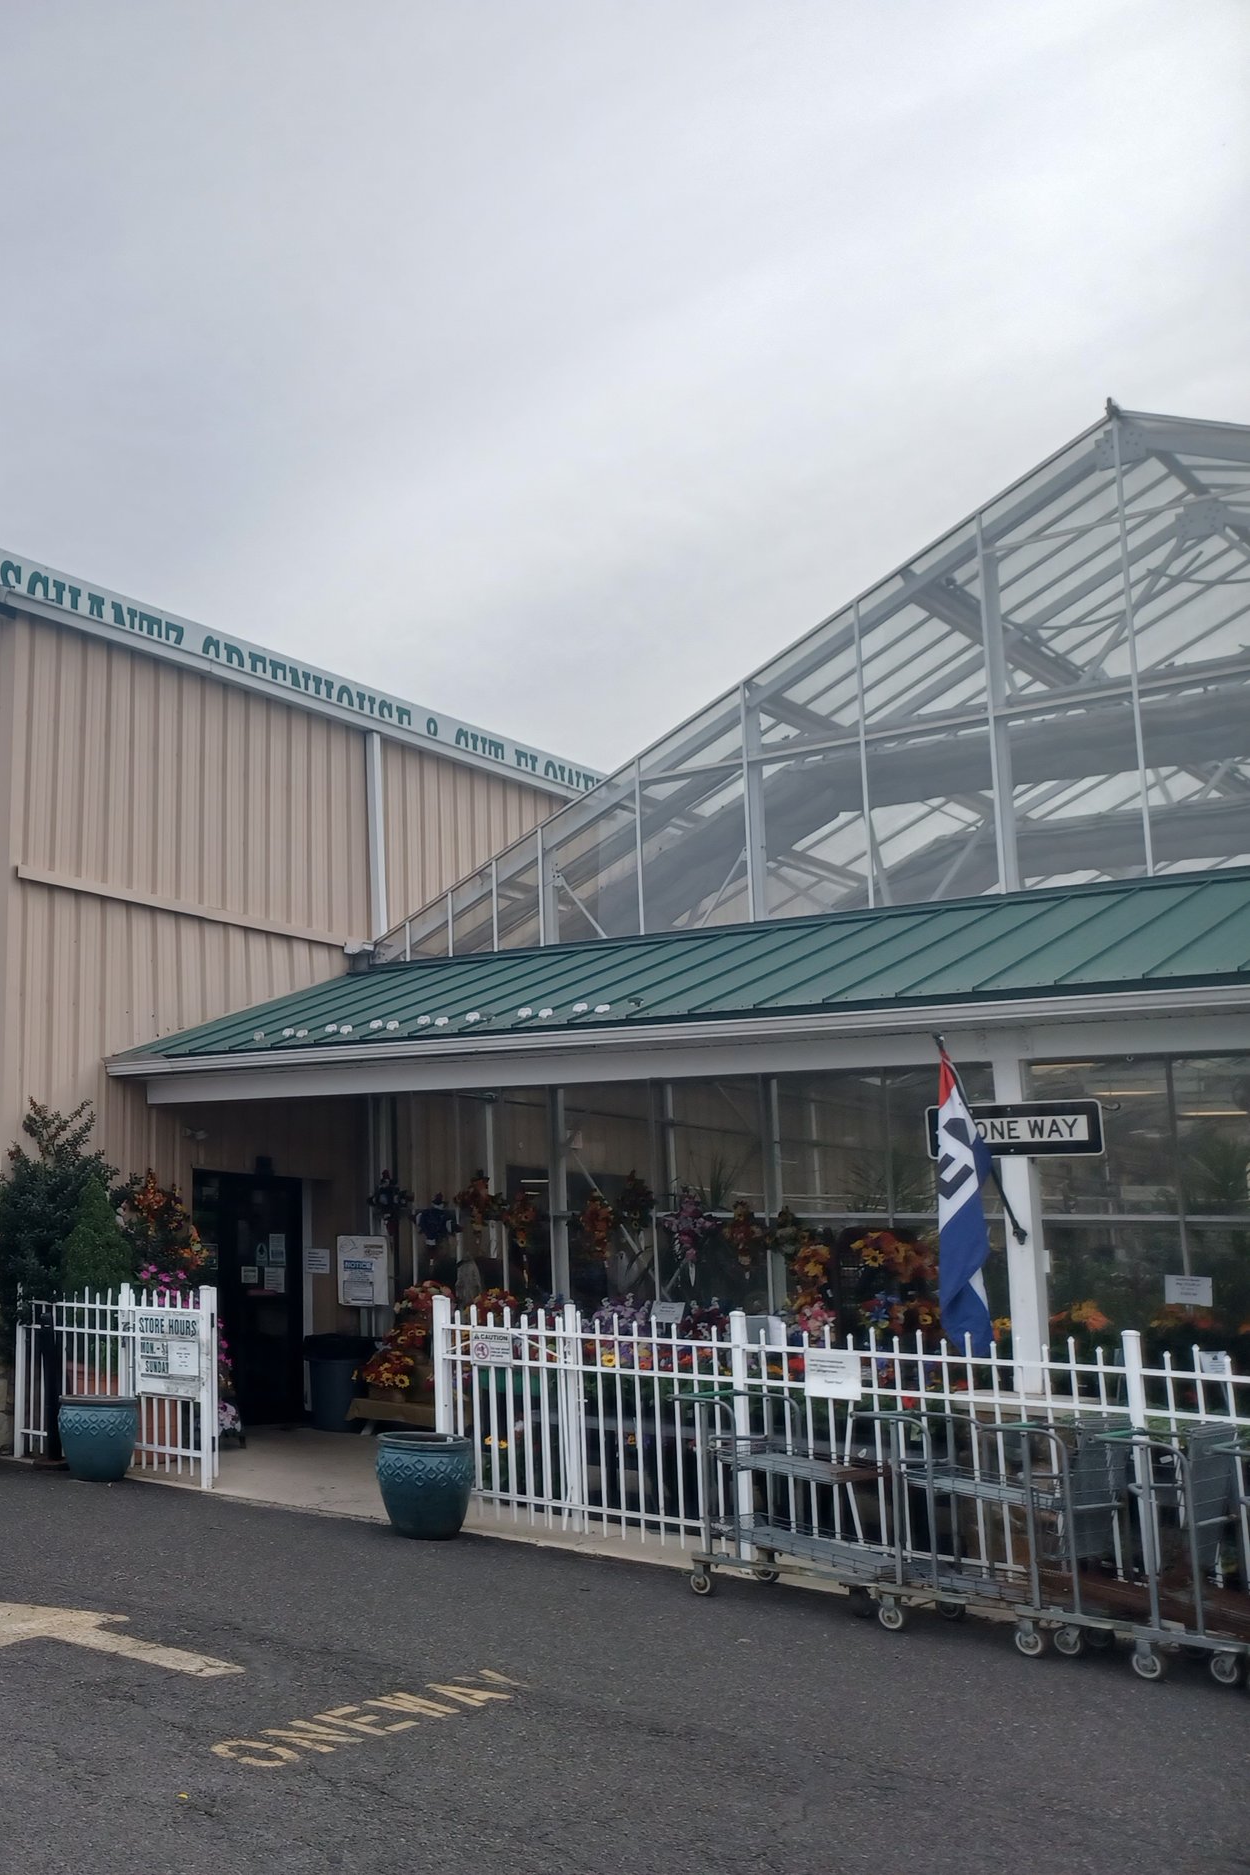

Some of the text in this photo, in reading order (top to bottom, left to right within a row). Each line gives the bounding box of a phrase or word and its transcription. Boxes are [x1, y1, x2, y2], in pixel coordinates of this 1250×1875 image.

[977, 1117, 1078, 1141] ONE WAY
[139, 1317, 197, 1338] STORE HOURS
[480, 1333, 508, 1341] CAUTION
